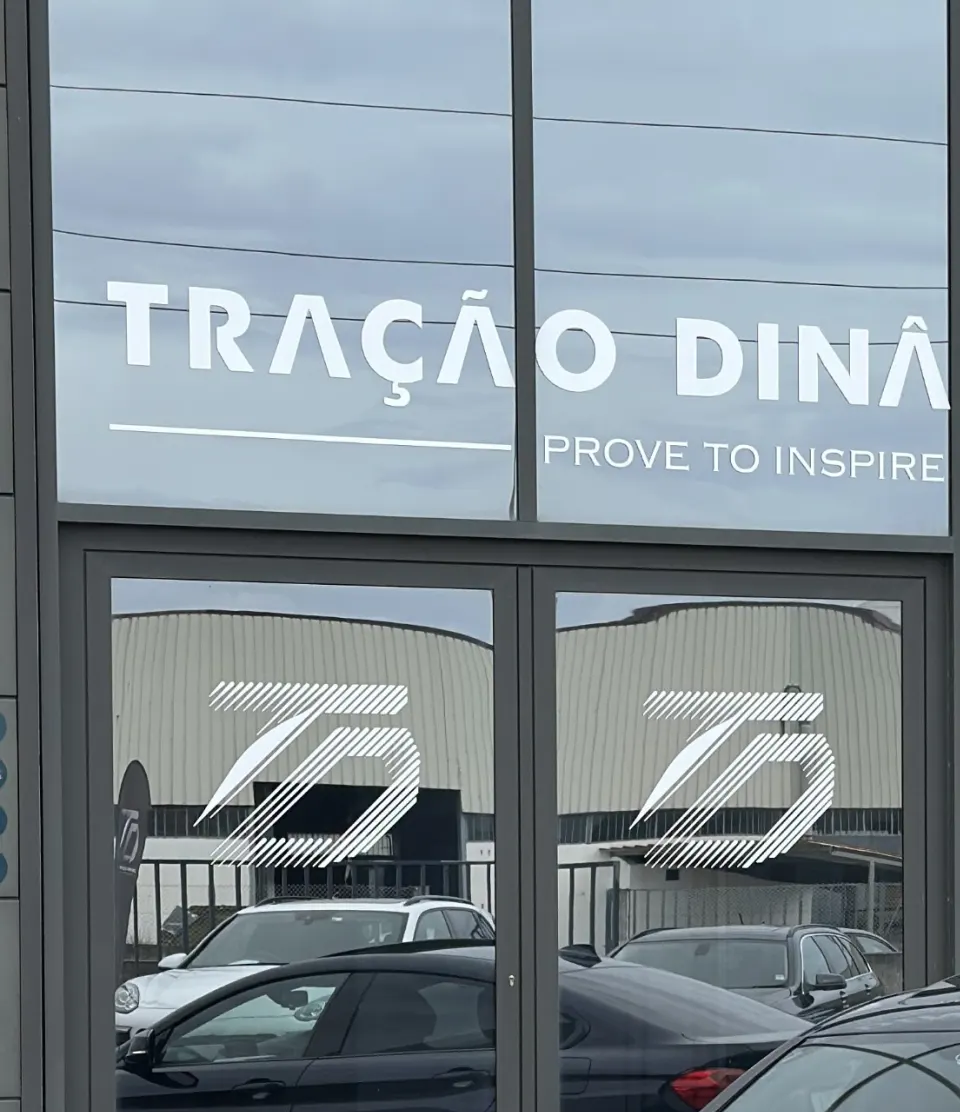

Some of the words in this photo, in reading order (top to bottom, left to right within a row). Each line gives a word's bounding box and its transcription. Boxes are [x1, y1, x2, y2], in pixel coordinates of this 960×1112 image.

[107, 281, 616, 407] TRAÇÃO
[543, 435, 690, 471] PROVE
[704, 442, 760, 474] TO
[775, 446, 945, 482] INSPIRE
